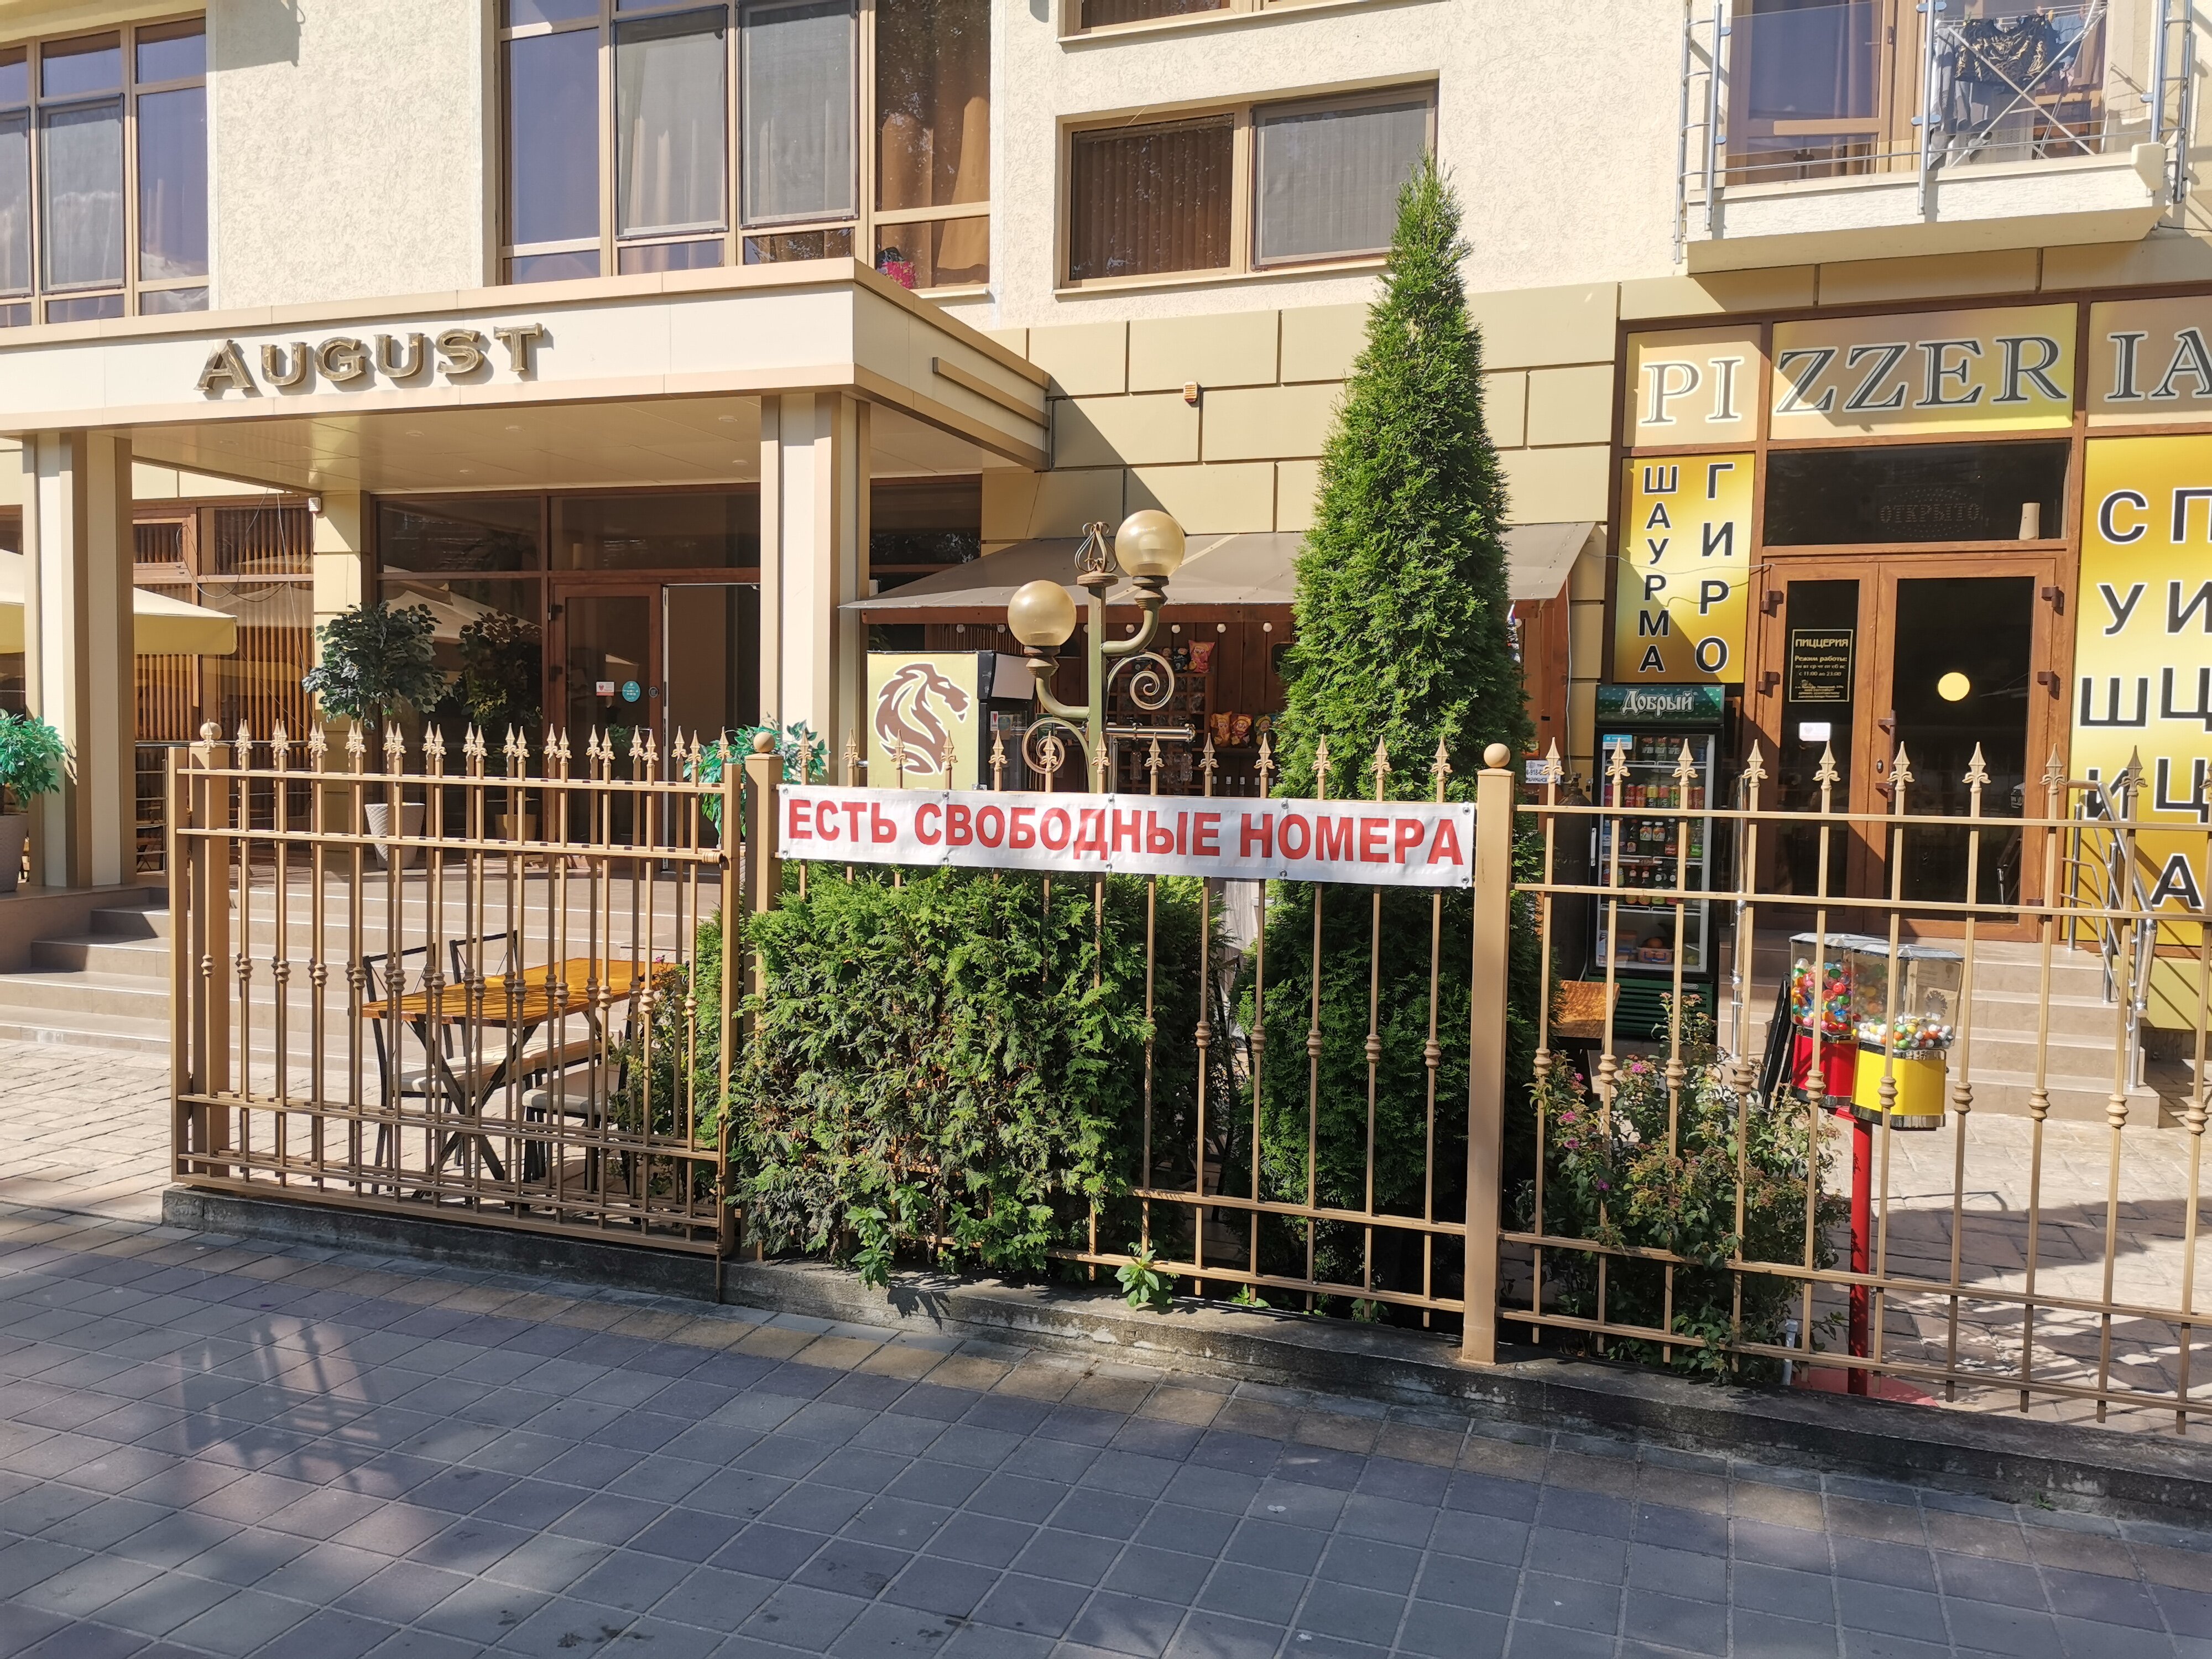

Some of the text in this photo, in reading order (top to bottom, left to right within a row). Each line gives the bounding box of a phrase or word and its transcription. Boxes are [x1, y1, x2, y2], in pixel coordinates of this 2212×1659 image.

[194, 322, 544, 390] AUGUST
[1638, 326, 2212, 427] PIZZERIA
[1880, 503, 1980, 523] ОТКРЫТО
[1637, 465, 1679, 673] ШАУРМА
[1695, 462, 1735, 673] ГИРО
[1795, 638, 1849, 649] ПИЦЦЕРИЯ
[1819, 655, 1848, 663] работы:
[2078, 488, 2149, 821] СУШИ
[1620, 688, 1694, 717] Добрый
[789, 799, 1464, 865] ЕСТЬ СВОБОДНЫЕ НОМЕРА
